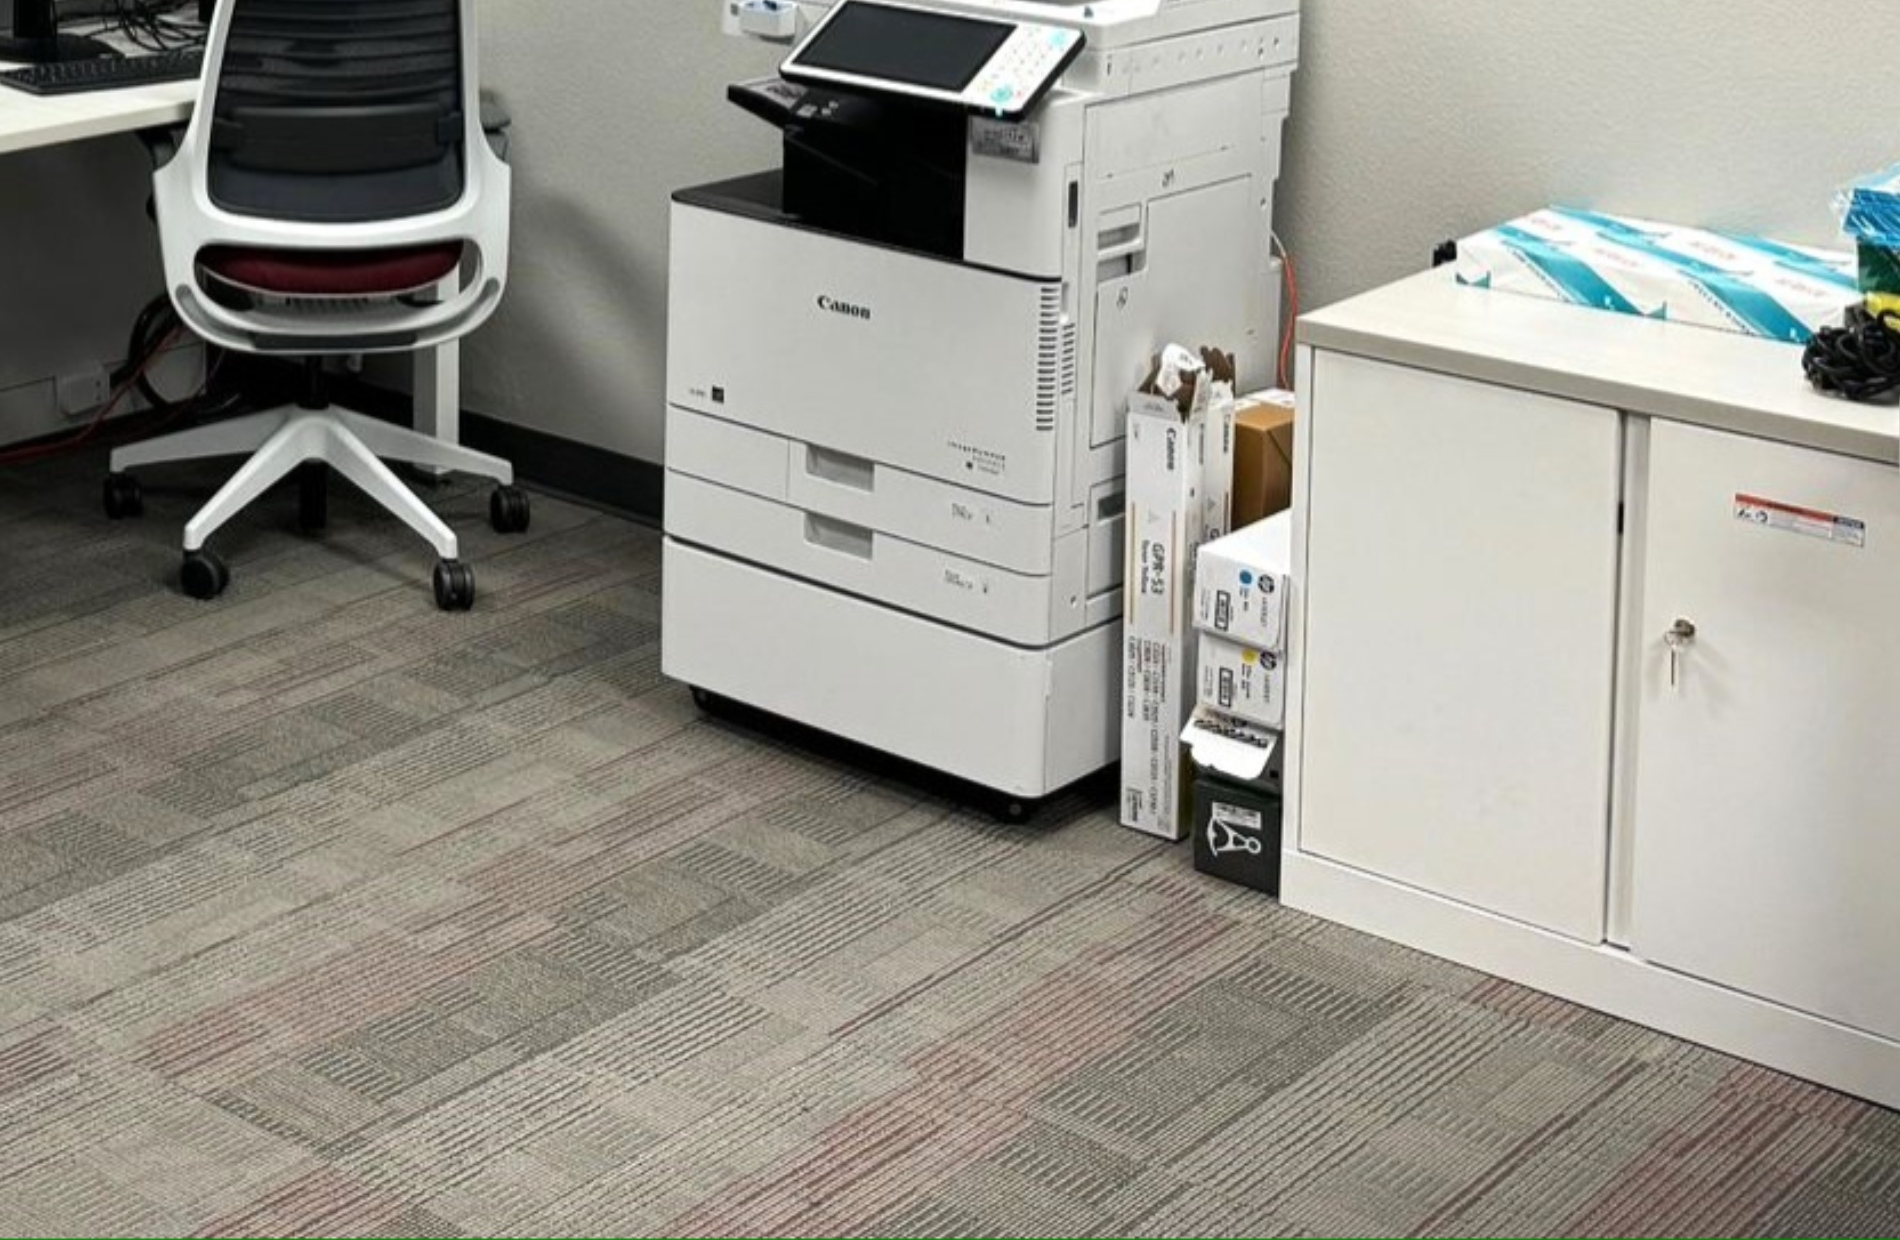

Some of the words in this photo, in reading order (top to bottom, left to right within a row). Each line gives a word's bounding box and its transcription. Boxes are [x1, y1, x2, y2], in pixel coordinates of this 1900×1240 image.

[817, 294, 872, 320] Canon
[1166, 427, 1177, 472] Canon
[1151, 542, 1166, 596] GPR-53
